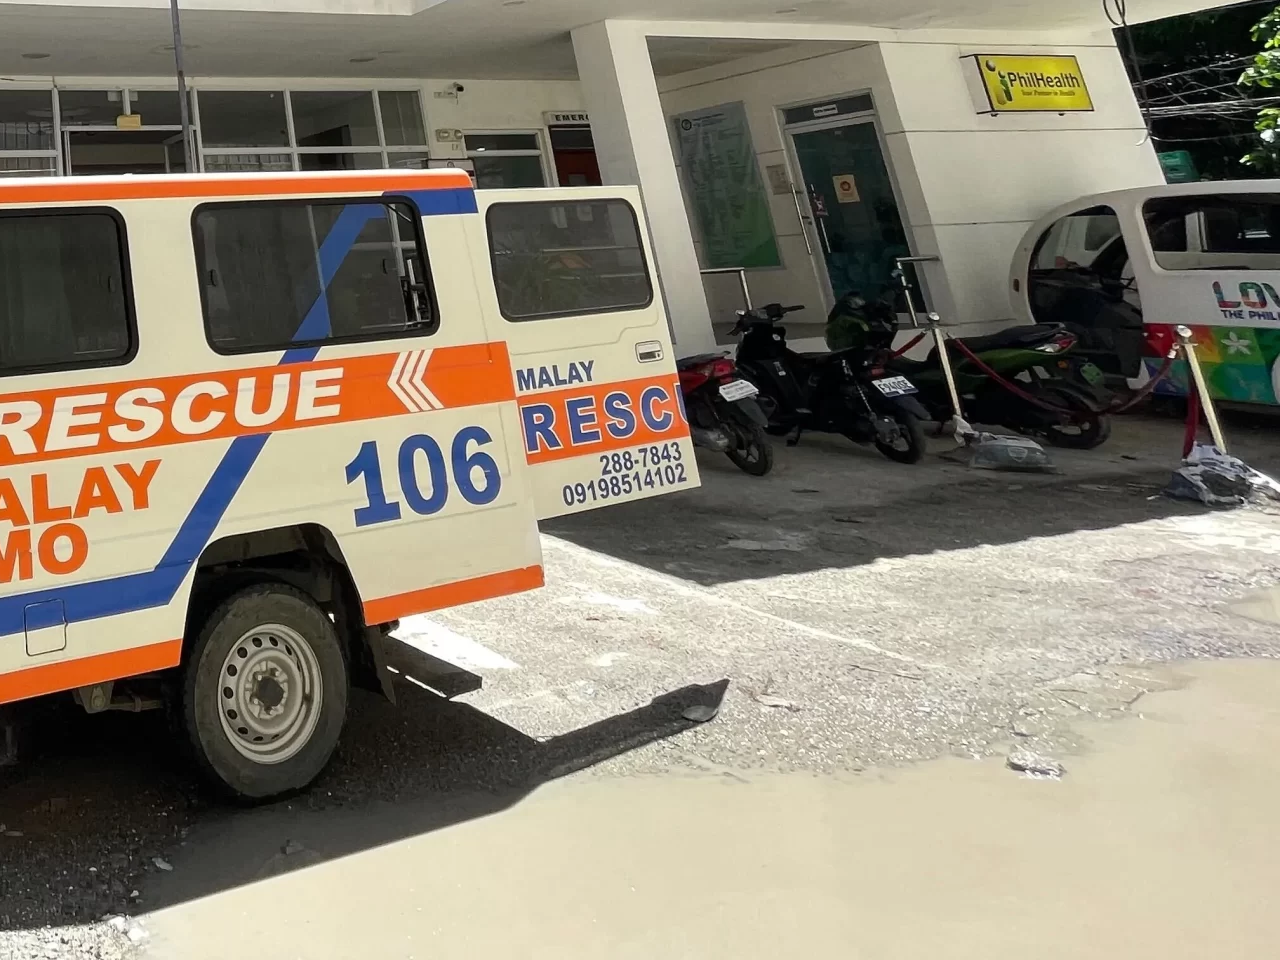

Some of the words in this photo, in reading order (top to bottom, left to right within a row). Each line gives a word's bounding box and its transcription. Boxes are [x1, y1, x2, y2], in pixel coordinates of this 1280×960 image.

[1006, 72, 1081, 88] PhilHealth
[1220, 309, 1245, 319] THE
[516, 360, 594, 392] MALAY
[599, 442, 682, 476] 288-7843
[344, 426, 501, 528] 106
[562, 463, 687, 506] 09198514102
